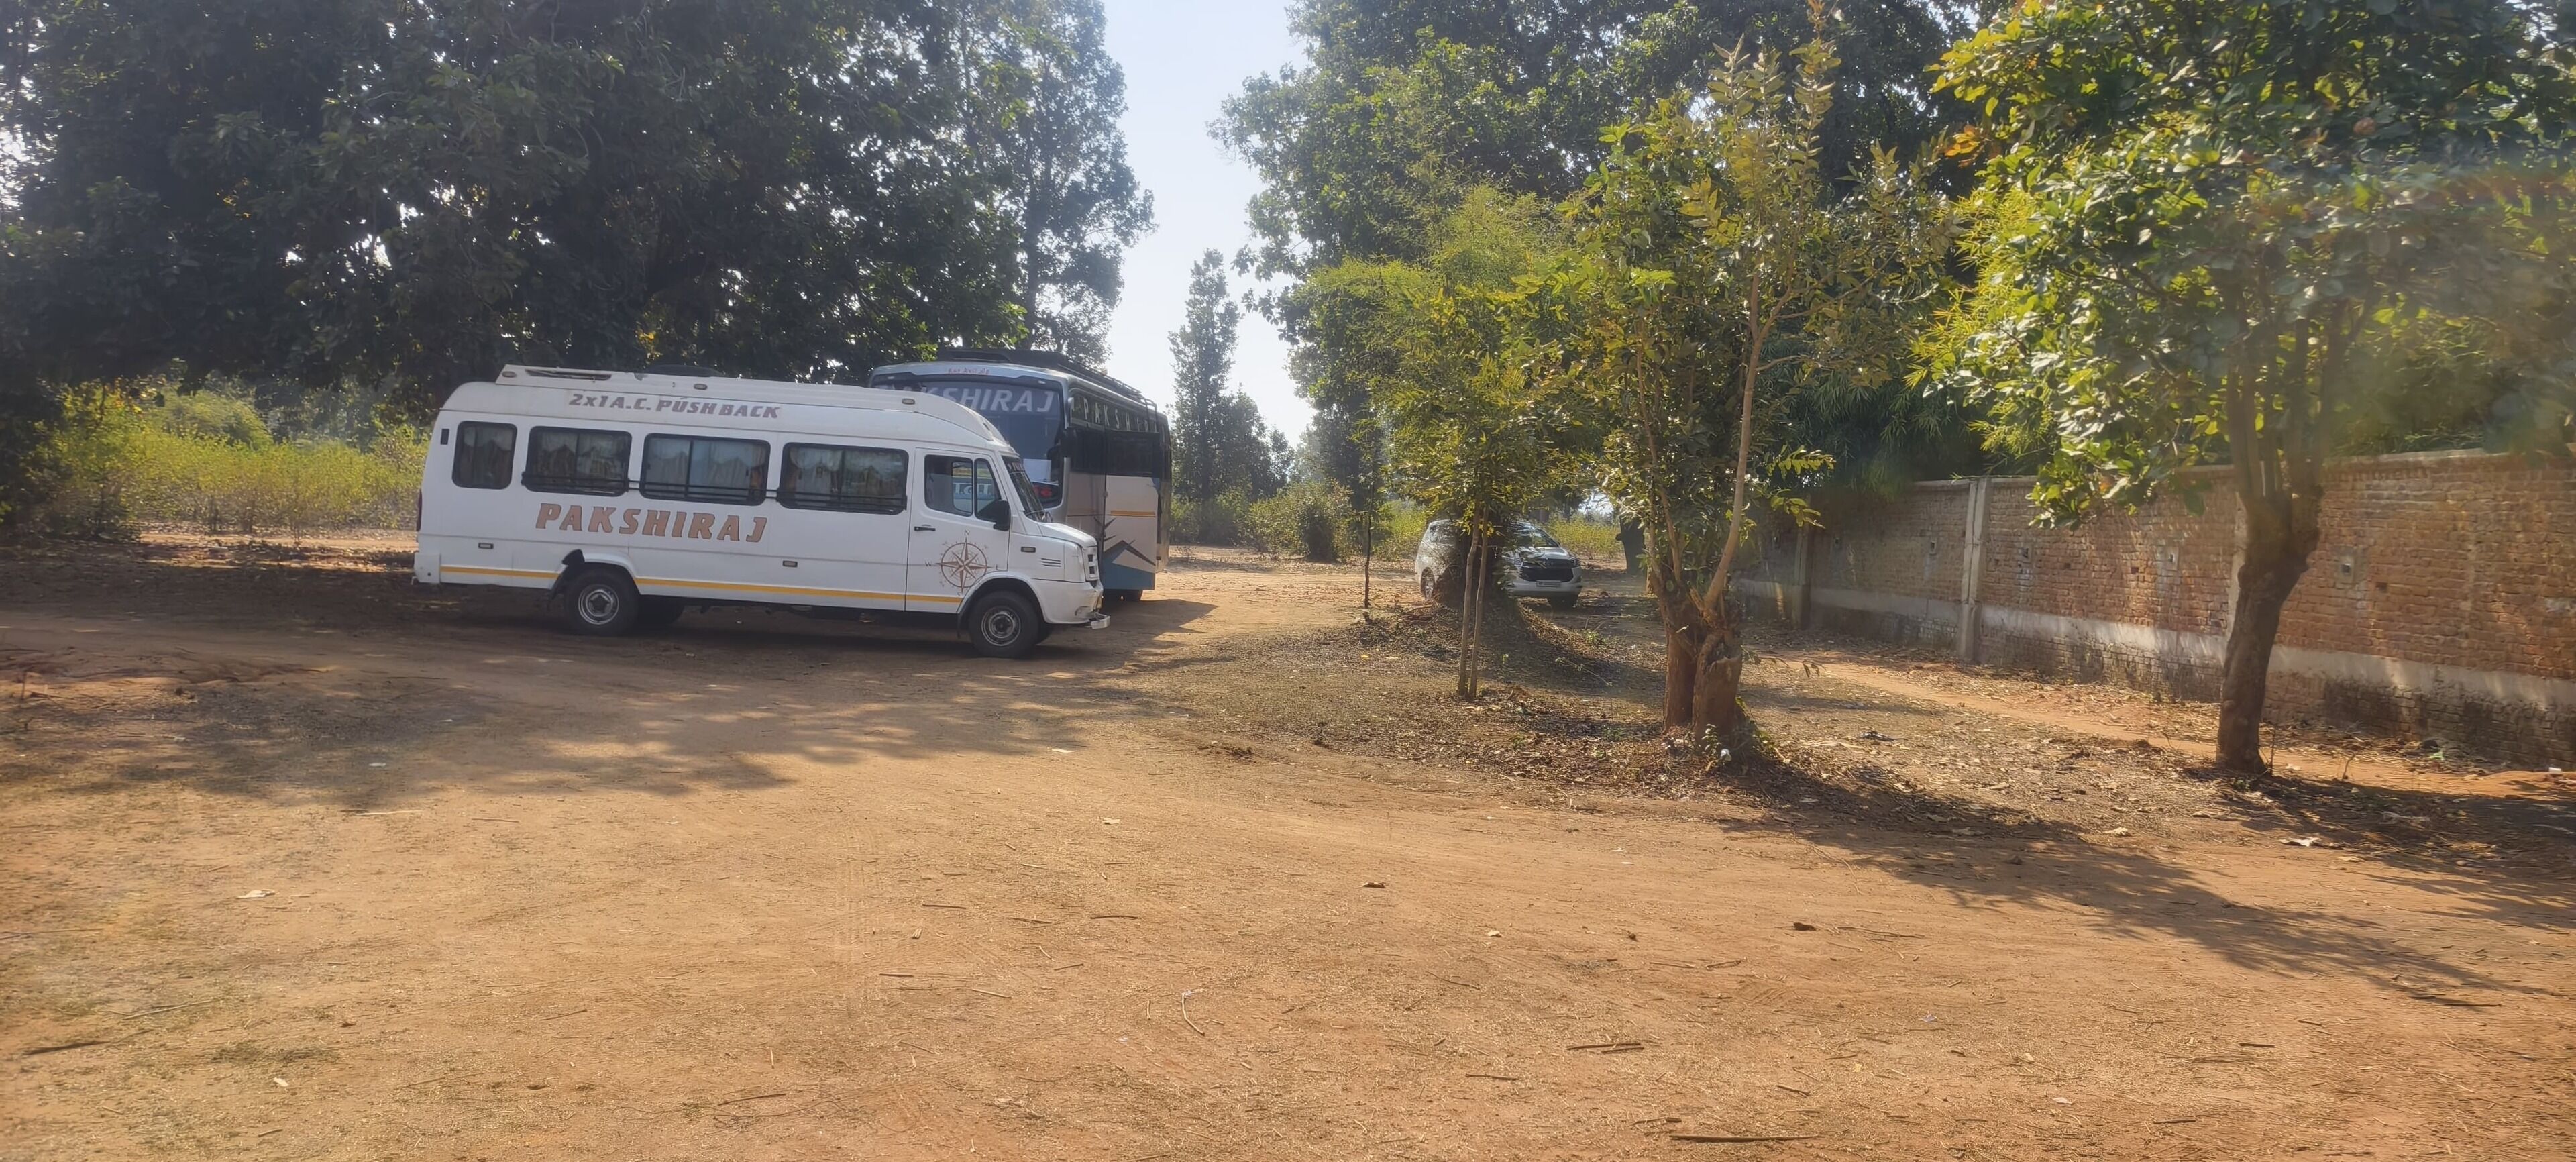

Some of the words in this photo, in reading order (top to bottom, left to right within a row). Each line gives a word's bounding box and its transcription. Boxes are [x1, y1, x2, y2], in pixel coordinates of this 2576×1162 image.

[609, 396, 651, 411] A.C.
[655, 399, 718, 415] PUSH
[718, 403, 780, 419] BACK
[875, 385, 1055, 412] SHIRAJ
[535, 503, 767, 543] PAKSHIRAJ
